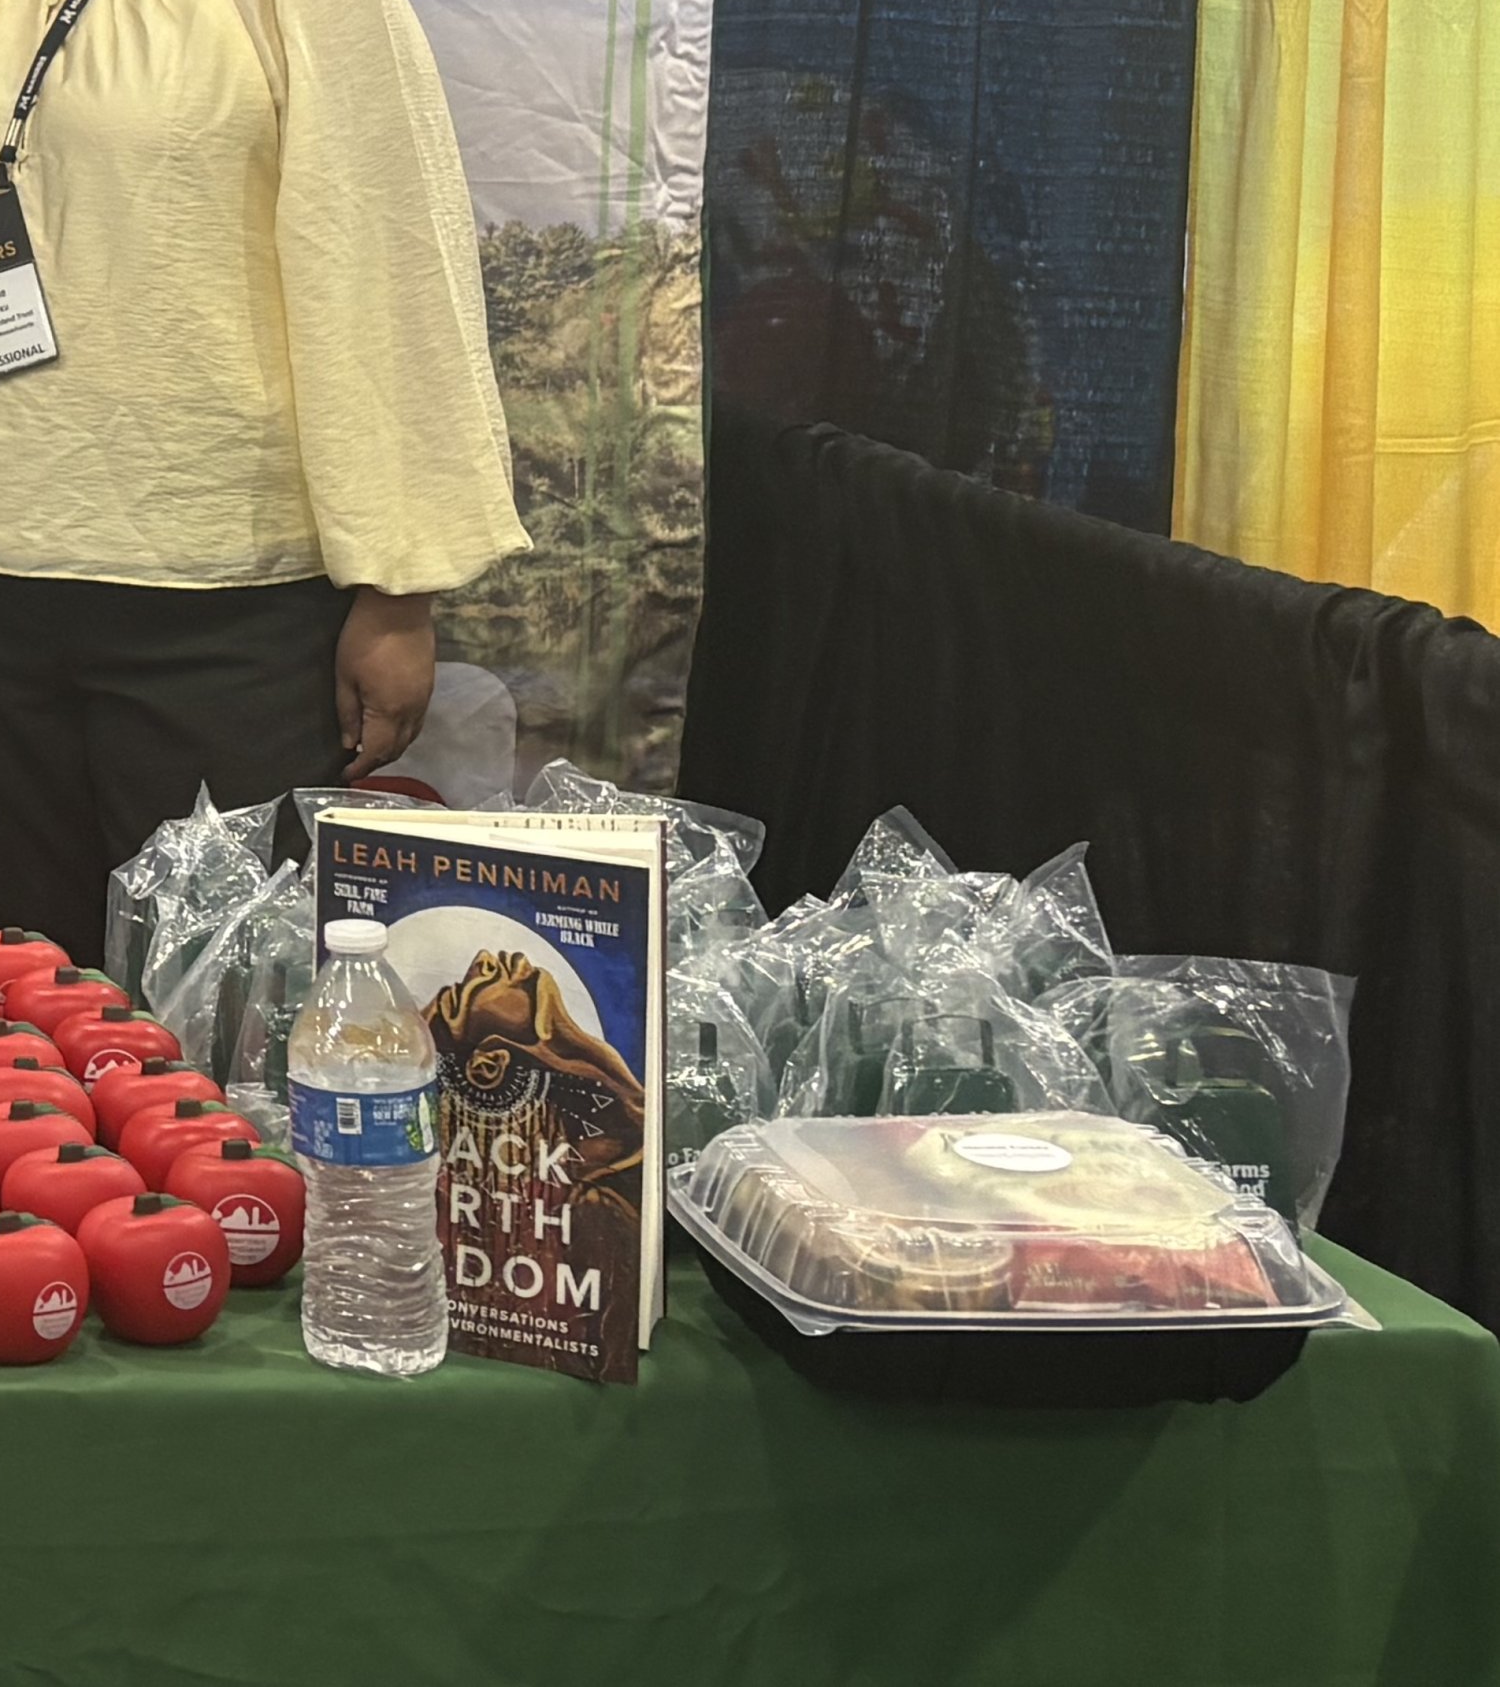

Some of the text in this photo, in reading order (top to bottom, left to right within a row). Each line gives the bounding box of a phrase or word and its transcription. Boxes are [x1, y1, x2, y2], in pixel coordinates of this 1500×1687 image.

[334, 839, 620, 903] LEAH PENNIMAN
[536, 911, 619, 937] FARMING WHILE
[447, 1125, 573, 1185] ACK
[450, 1183, 572, 1245] RTH
[456, 1244, 601, 1311] DOM
[447, 1299, 569, 1334] ONVERSATIONS
[450, 1318, 600, 1357] VIRONMENTALISTS
